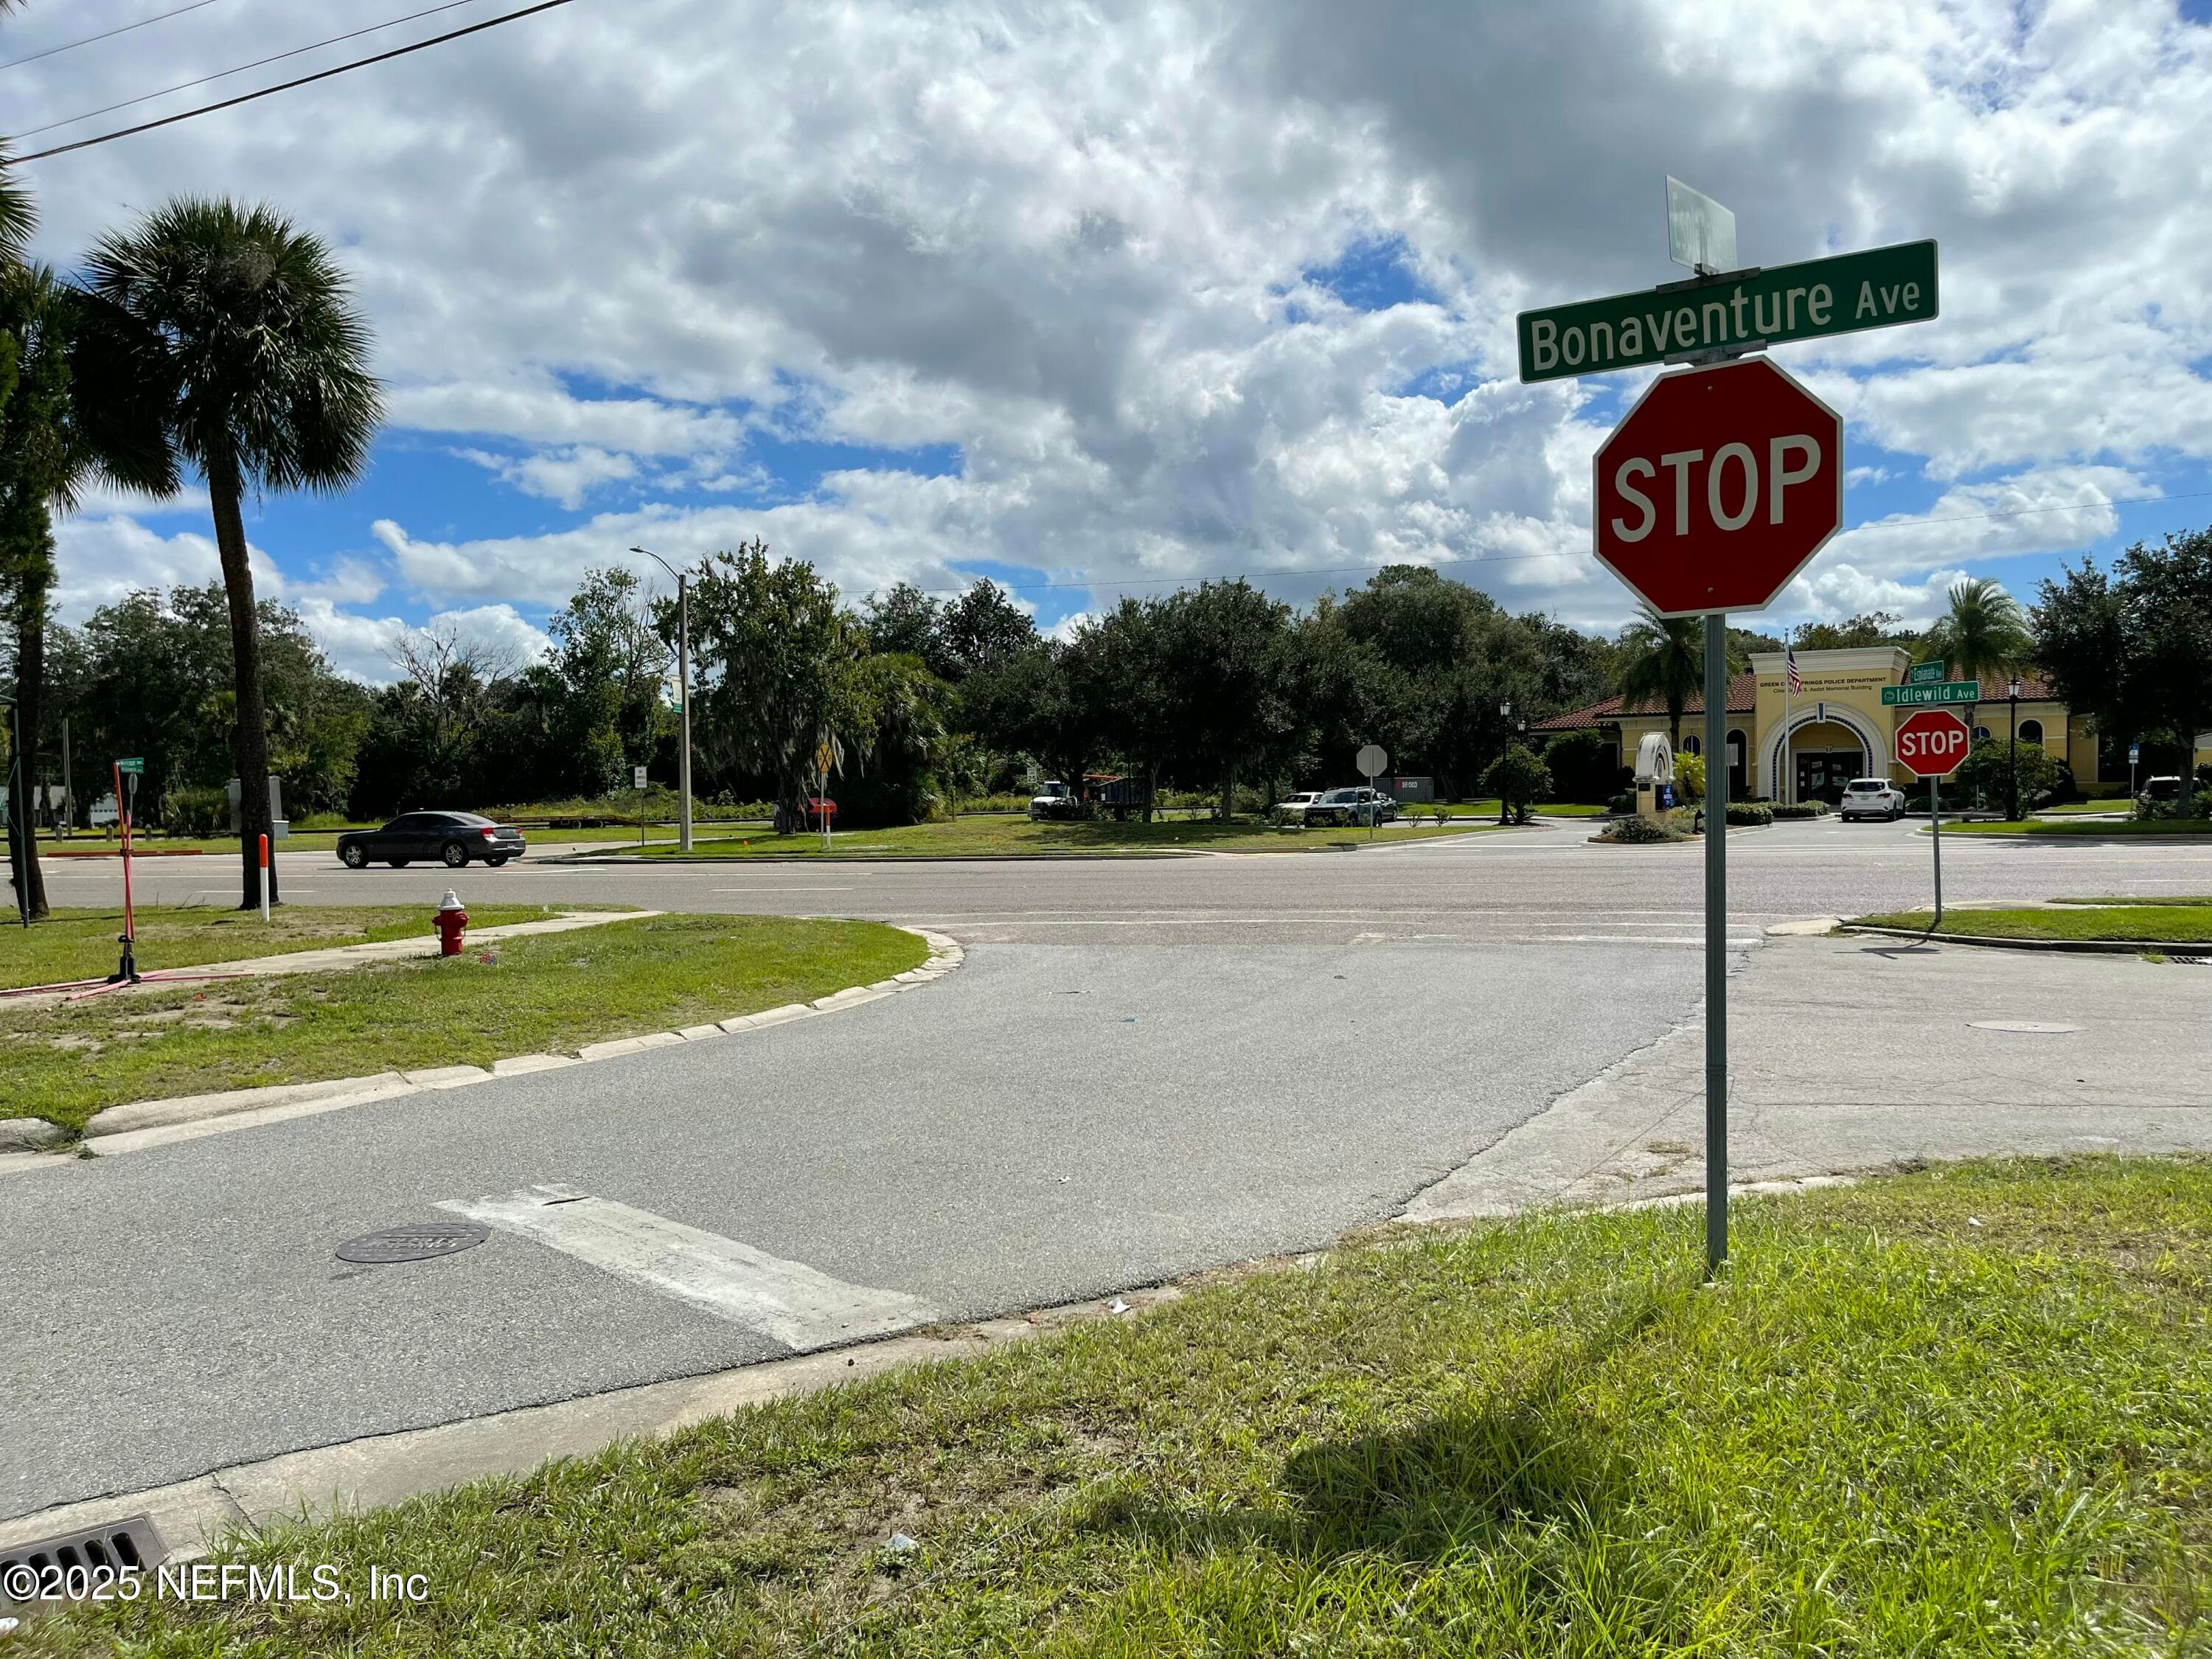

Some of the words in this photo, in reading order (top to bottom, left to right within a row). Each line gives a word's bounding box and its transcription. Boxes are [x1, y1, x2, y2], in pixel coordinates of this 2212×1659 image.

[1531, 283, 1833, 371] Bonaventure
[1855, 281, 1920, 319] Ave
[1611, 434, 1822, 543] STOP
[1896, 686, 1950, 703] Idlewild
[1957, 689, 1975, 699] Ave
[1901, 730, 1964, 757] STOP
